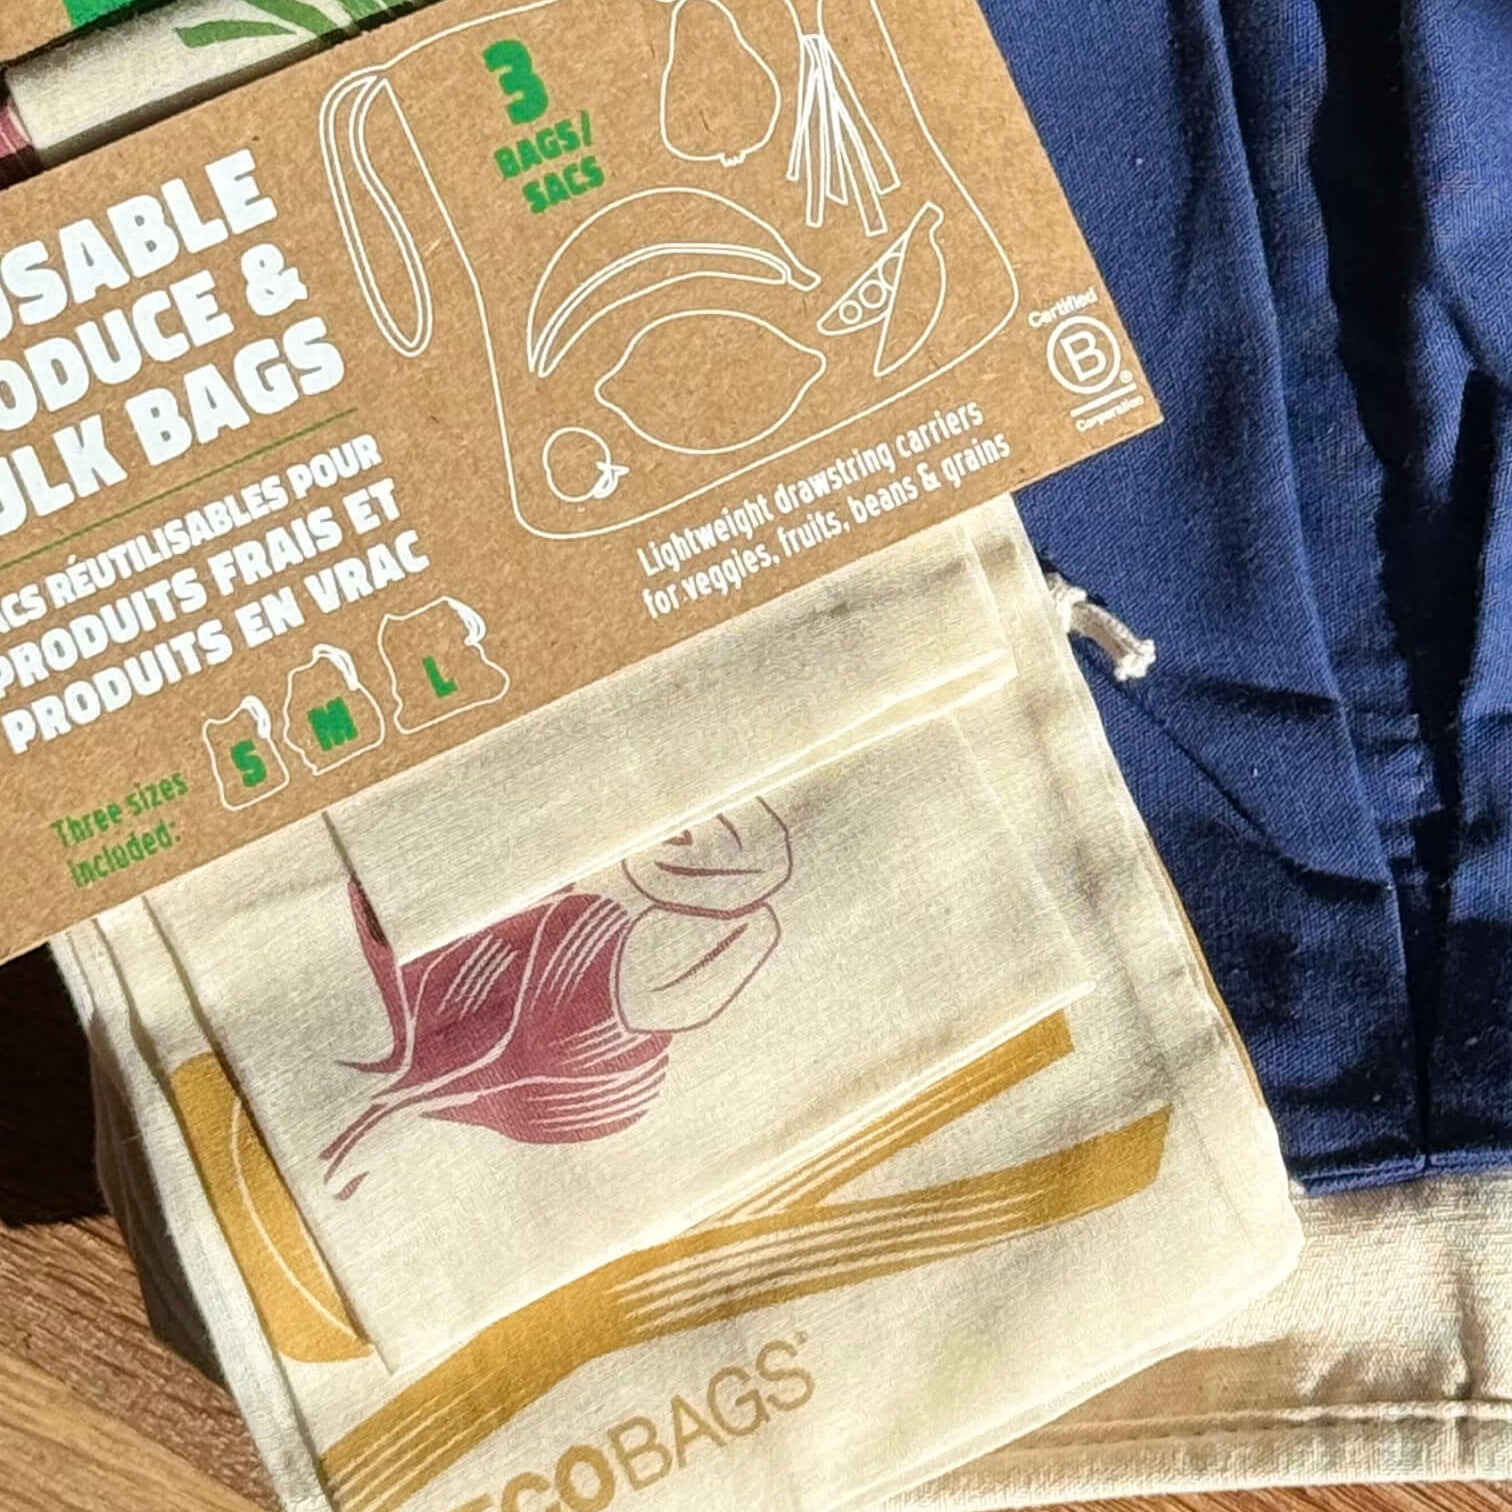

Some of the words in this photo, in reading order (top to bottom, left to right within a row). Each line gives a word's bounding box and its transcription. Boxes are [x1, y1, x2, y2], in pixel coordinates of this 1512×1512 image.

[482, 39, 549, 125] 3
[494, 109, 592, 178] BAGS/
[522, 155, 605, 214] SACS
[0, 148, 277, 341] SABLE
[241, 243, 308, 316] &
[1028, 286, 1098, 328] Certified
[125, 316, 344, 466] BAGS
[1060, 331, 1107, 382] B
[1075, 395, 1145, 433] Corporation
[45, 474, 289, 609] RÉUTILISABLES
[286, 434, 382, 500] POUR
[636, 495, 775, 577] Lightweight
[773, 441, 897, 515] drawstring
[895, 401, 984, 458] carriers
[642, 582, 681, 619] for
[680, 542, 781, 600] veggies,
[775, 509, 850, 559] fruits,
[847, 475, 919, 525] beans
[916, 461, 941, 493] &
[940, 432, 1011, 489] grains
[207, 506, 343, 596] FRAIS
[342, 477, 400, 535] ET
[1, 619, 233, 755] PRODUITS
[234, 586, 305, 648] EN
[303, 529, 430, 614] VRAC
[230, 740, 268, 788] S
[306, 696, 359, 752] M
[422, 655, 458, 699] L
[50, 803, 122, 848] Three
[125, 772, 188, 817] sizes
[67, 819, 181, 888] included:
